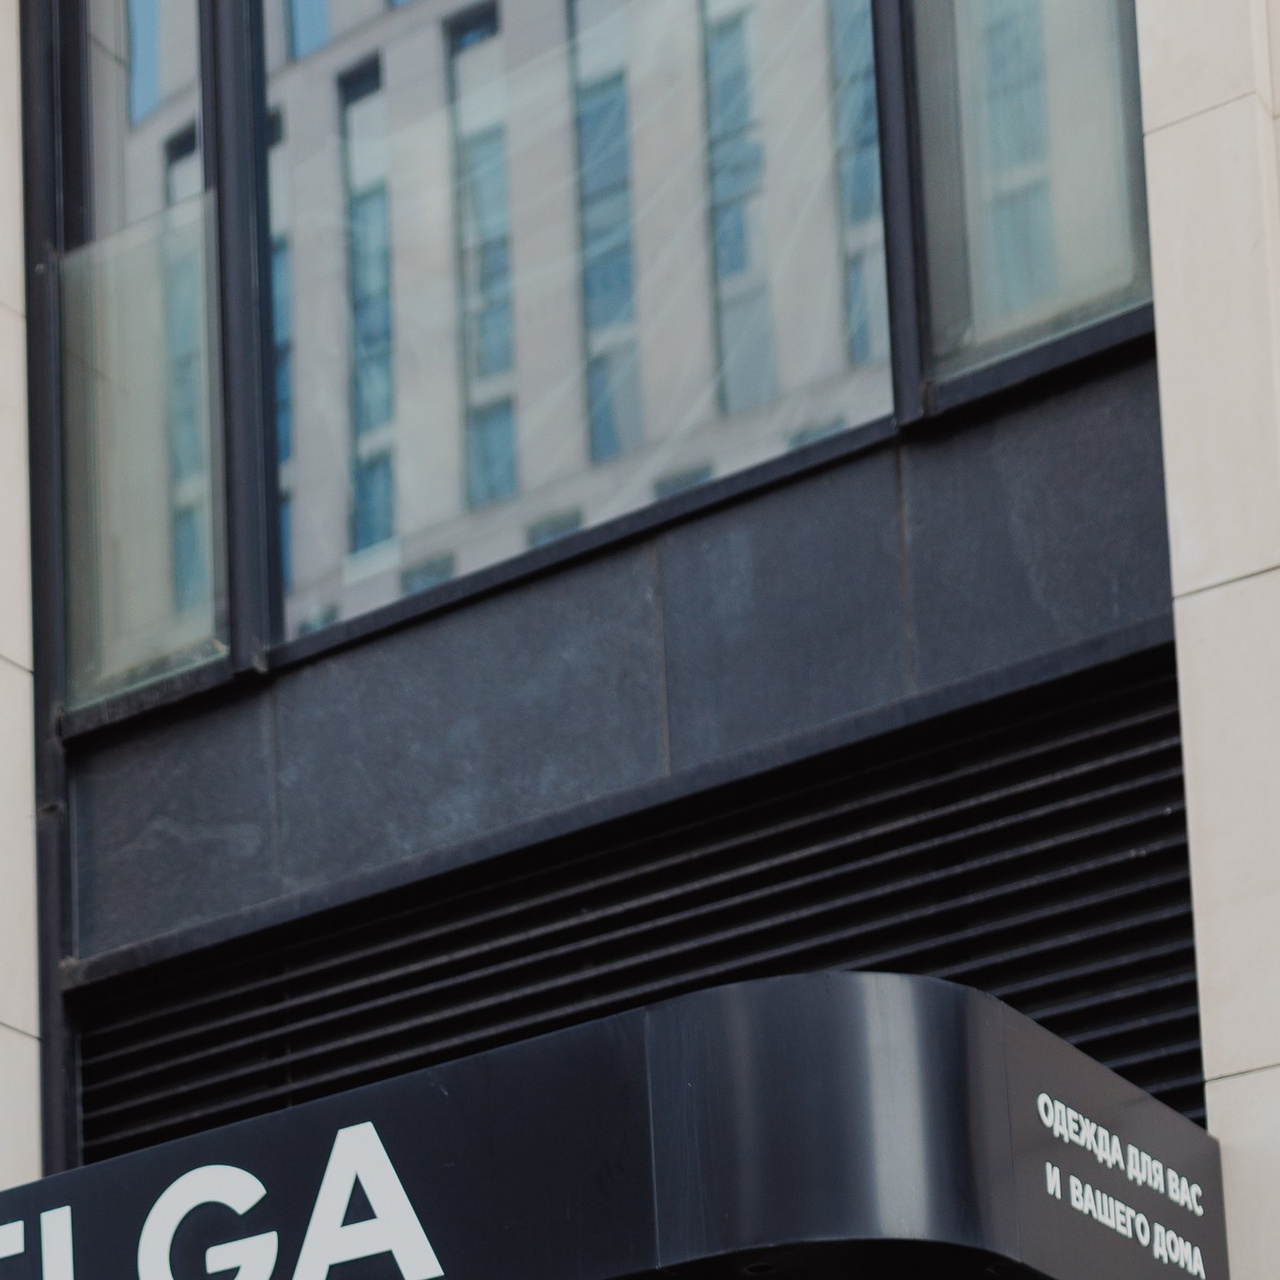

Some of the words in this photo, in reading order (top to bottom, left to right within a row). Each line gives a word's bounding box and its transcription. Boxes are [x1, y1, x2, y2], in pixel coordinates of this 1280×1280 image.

[1036, 1092, 1125, 1171] ОДЕЖДА
[1127, 1143, 1165, 1194] ДЛЯ
[1167, 1167, 1204, 1217] ВАС
[1045, 1161, 1062, 1200] И
[1069, 1174, 1150, 1247] ВАШЕГО
[1153, 1222, 1206, 1280] ДОМА
